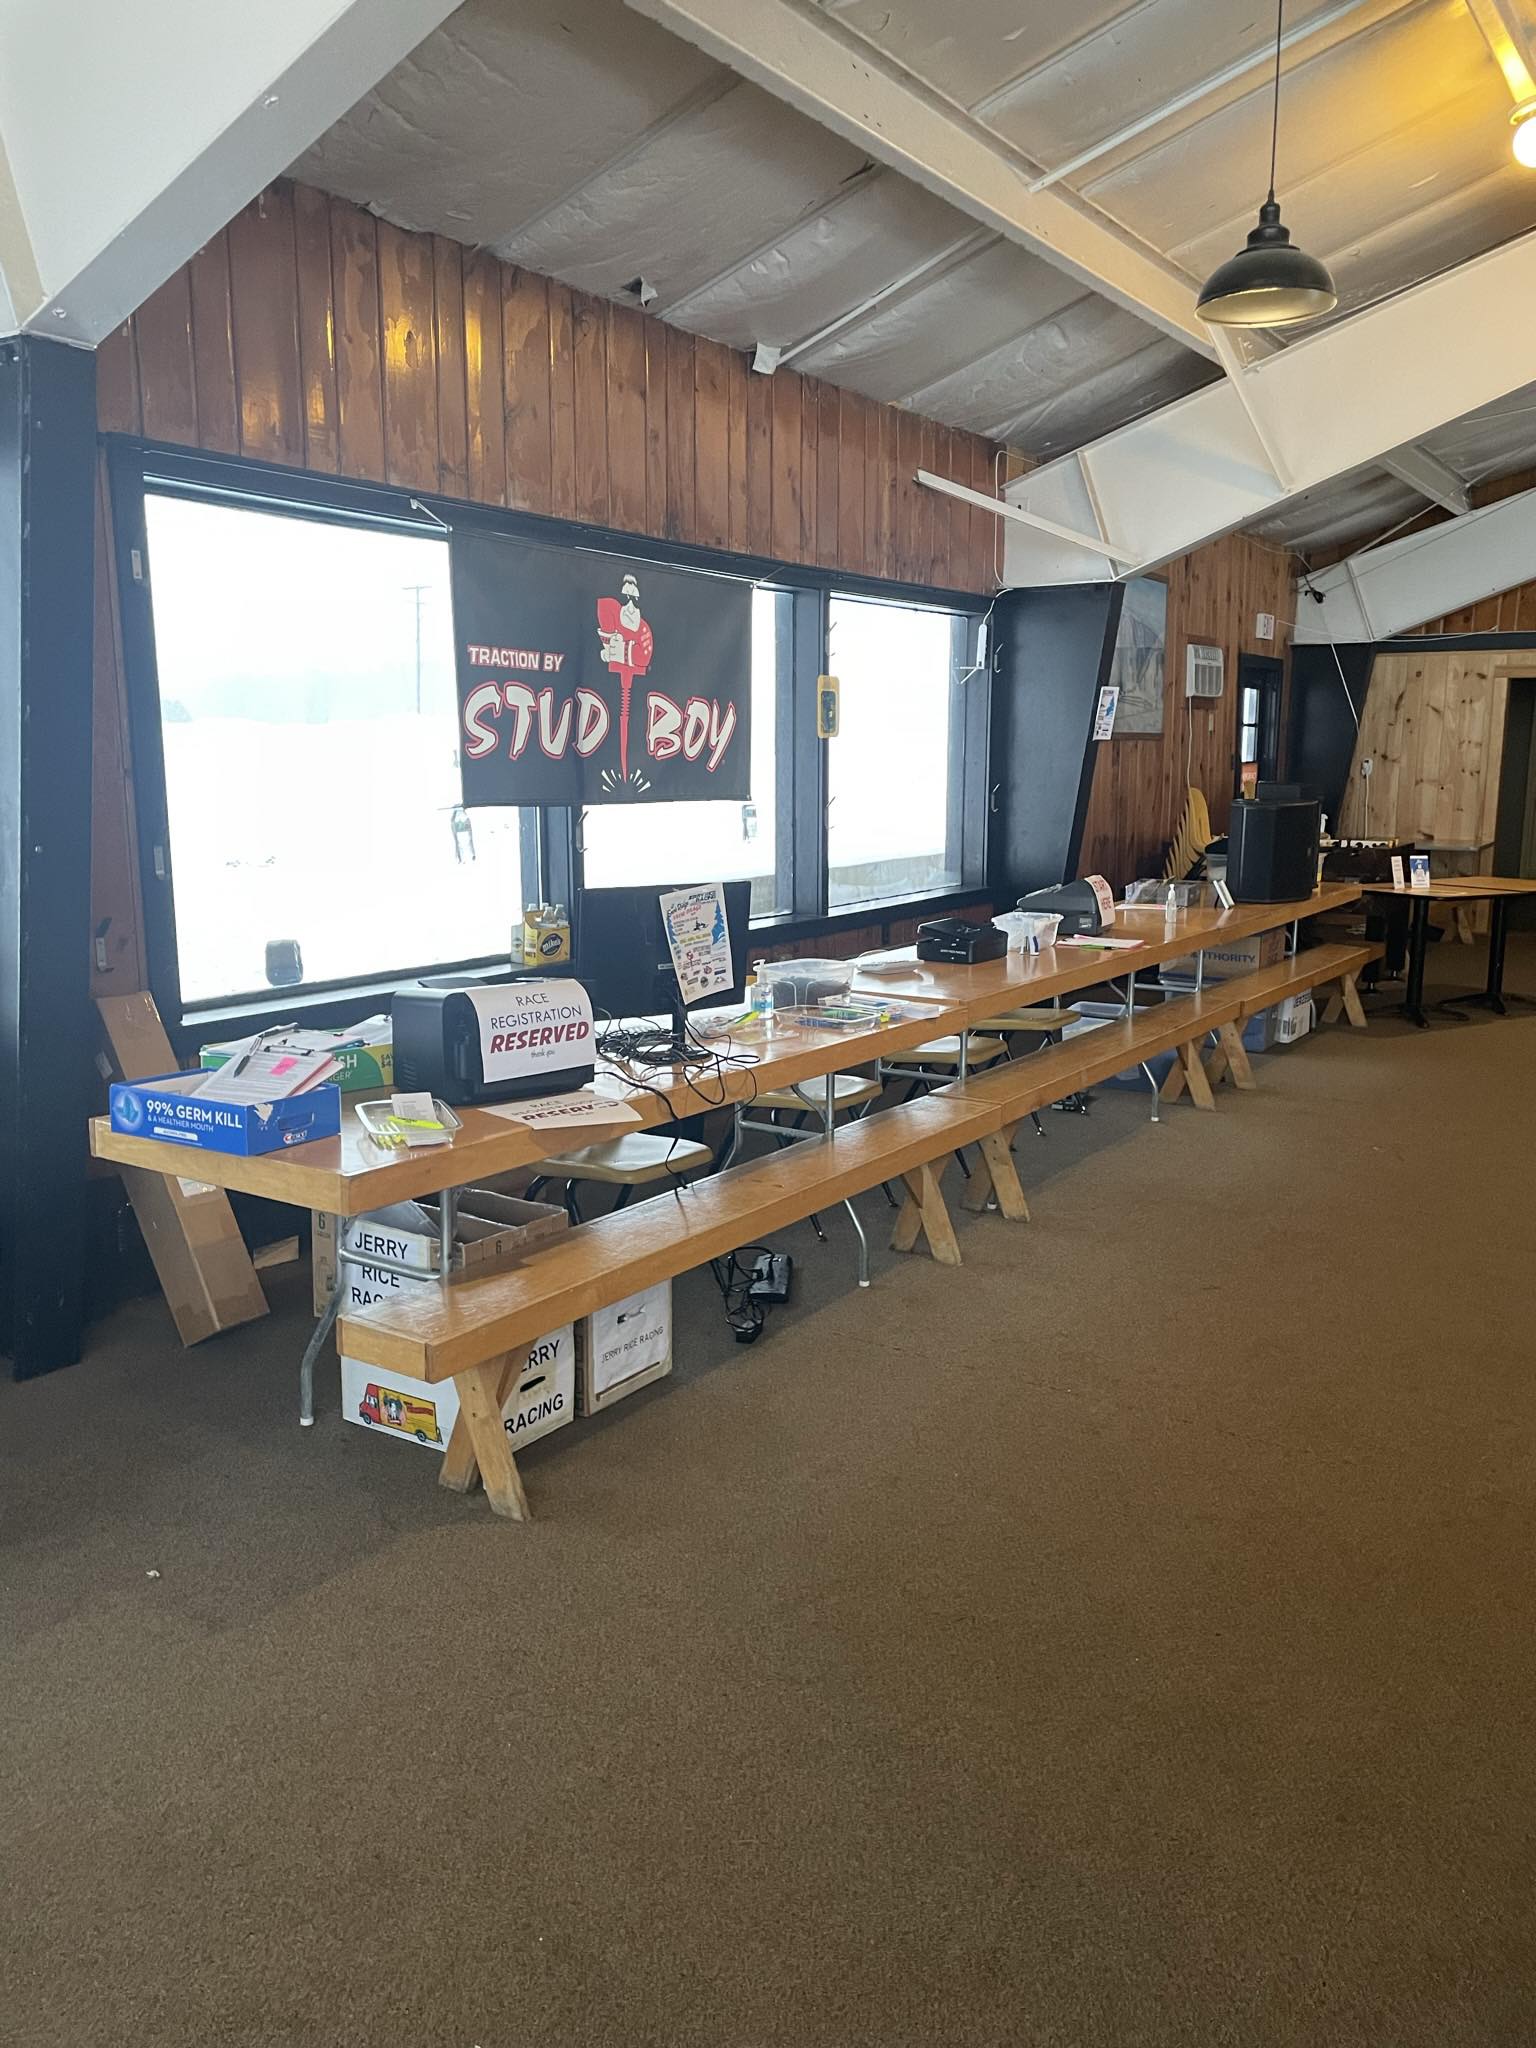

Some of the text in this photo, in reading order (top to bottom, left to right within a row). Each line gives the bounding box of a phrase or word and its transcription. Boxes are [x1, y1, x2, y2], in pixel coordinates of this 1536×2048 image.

[468, 646, 563, 671] TRACTION BY
[464, 681, 736, 772] STUD BOY
[515, 992, 550, 1007] RACE
[490, 1005, 582, 1030] REGISTRATION
[490, 1021, 590, 1054] RESERVED
[146, 1100, 243, 1129] 99% GERM KILL
[160, 1116, 190, 1128] HEALTHIER
[191, 1123, 214, 1132] MOUTH
[355, 1231, 408, 1259] JERRY
[362, 1264, 400, 1288] RICE
[351, 1286, 384, 1306] RAC
[521, 1339, 560, 1373] RRY
[601, 1326, 664, 1364] JERRY RICE RACING
[504, 1393, 563, 1434] RACING
